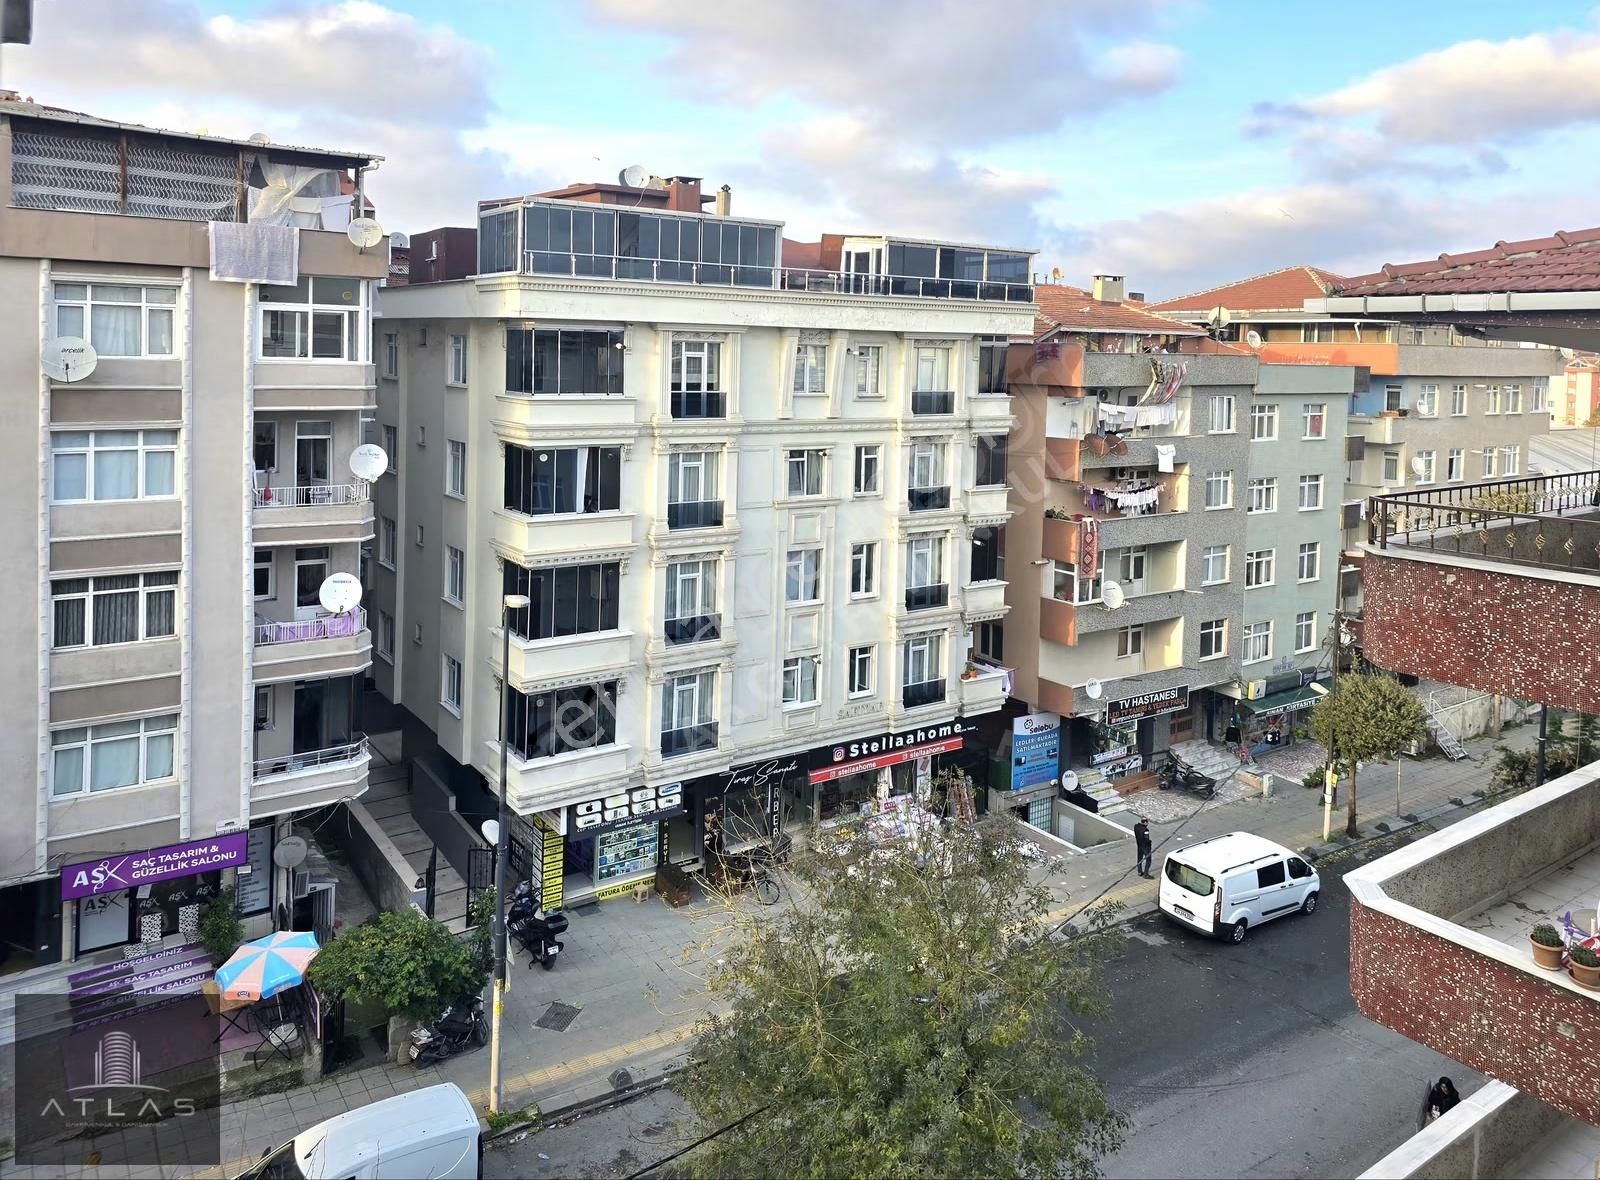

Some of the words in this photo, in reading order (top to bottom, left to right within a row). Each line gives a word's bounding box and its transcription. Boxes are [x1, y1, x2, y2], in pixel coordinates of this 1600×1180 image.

[1119, 700, 1131, 710] TV
[850, 723, 962, 757] Stellaahome
[909, 745, 946, 759] stellaahome
[838, 761, 877, 777] stellaahome
[132, 857, 156, 870] SAÇ
[158, 846, 208, 864] TASARIM
[210, 845, 219, 853] &
[132, 860, 189, 879] GÜZELLİK
[191, 851, 237, 868] SALONU
[598, 887, 620, 898] FATURA
[113, 947, 184, 971] HOŞGELDİNİZ
[124, 974, 146, 984] SAÇ
[148, 961, 193, 977] TASARIM
[166, 974, 206, 990] SALONU
